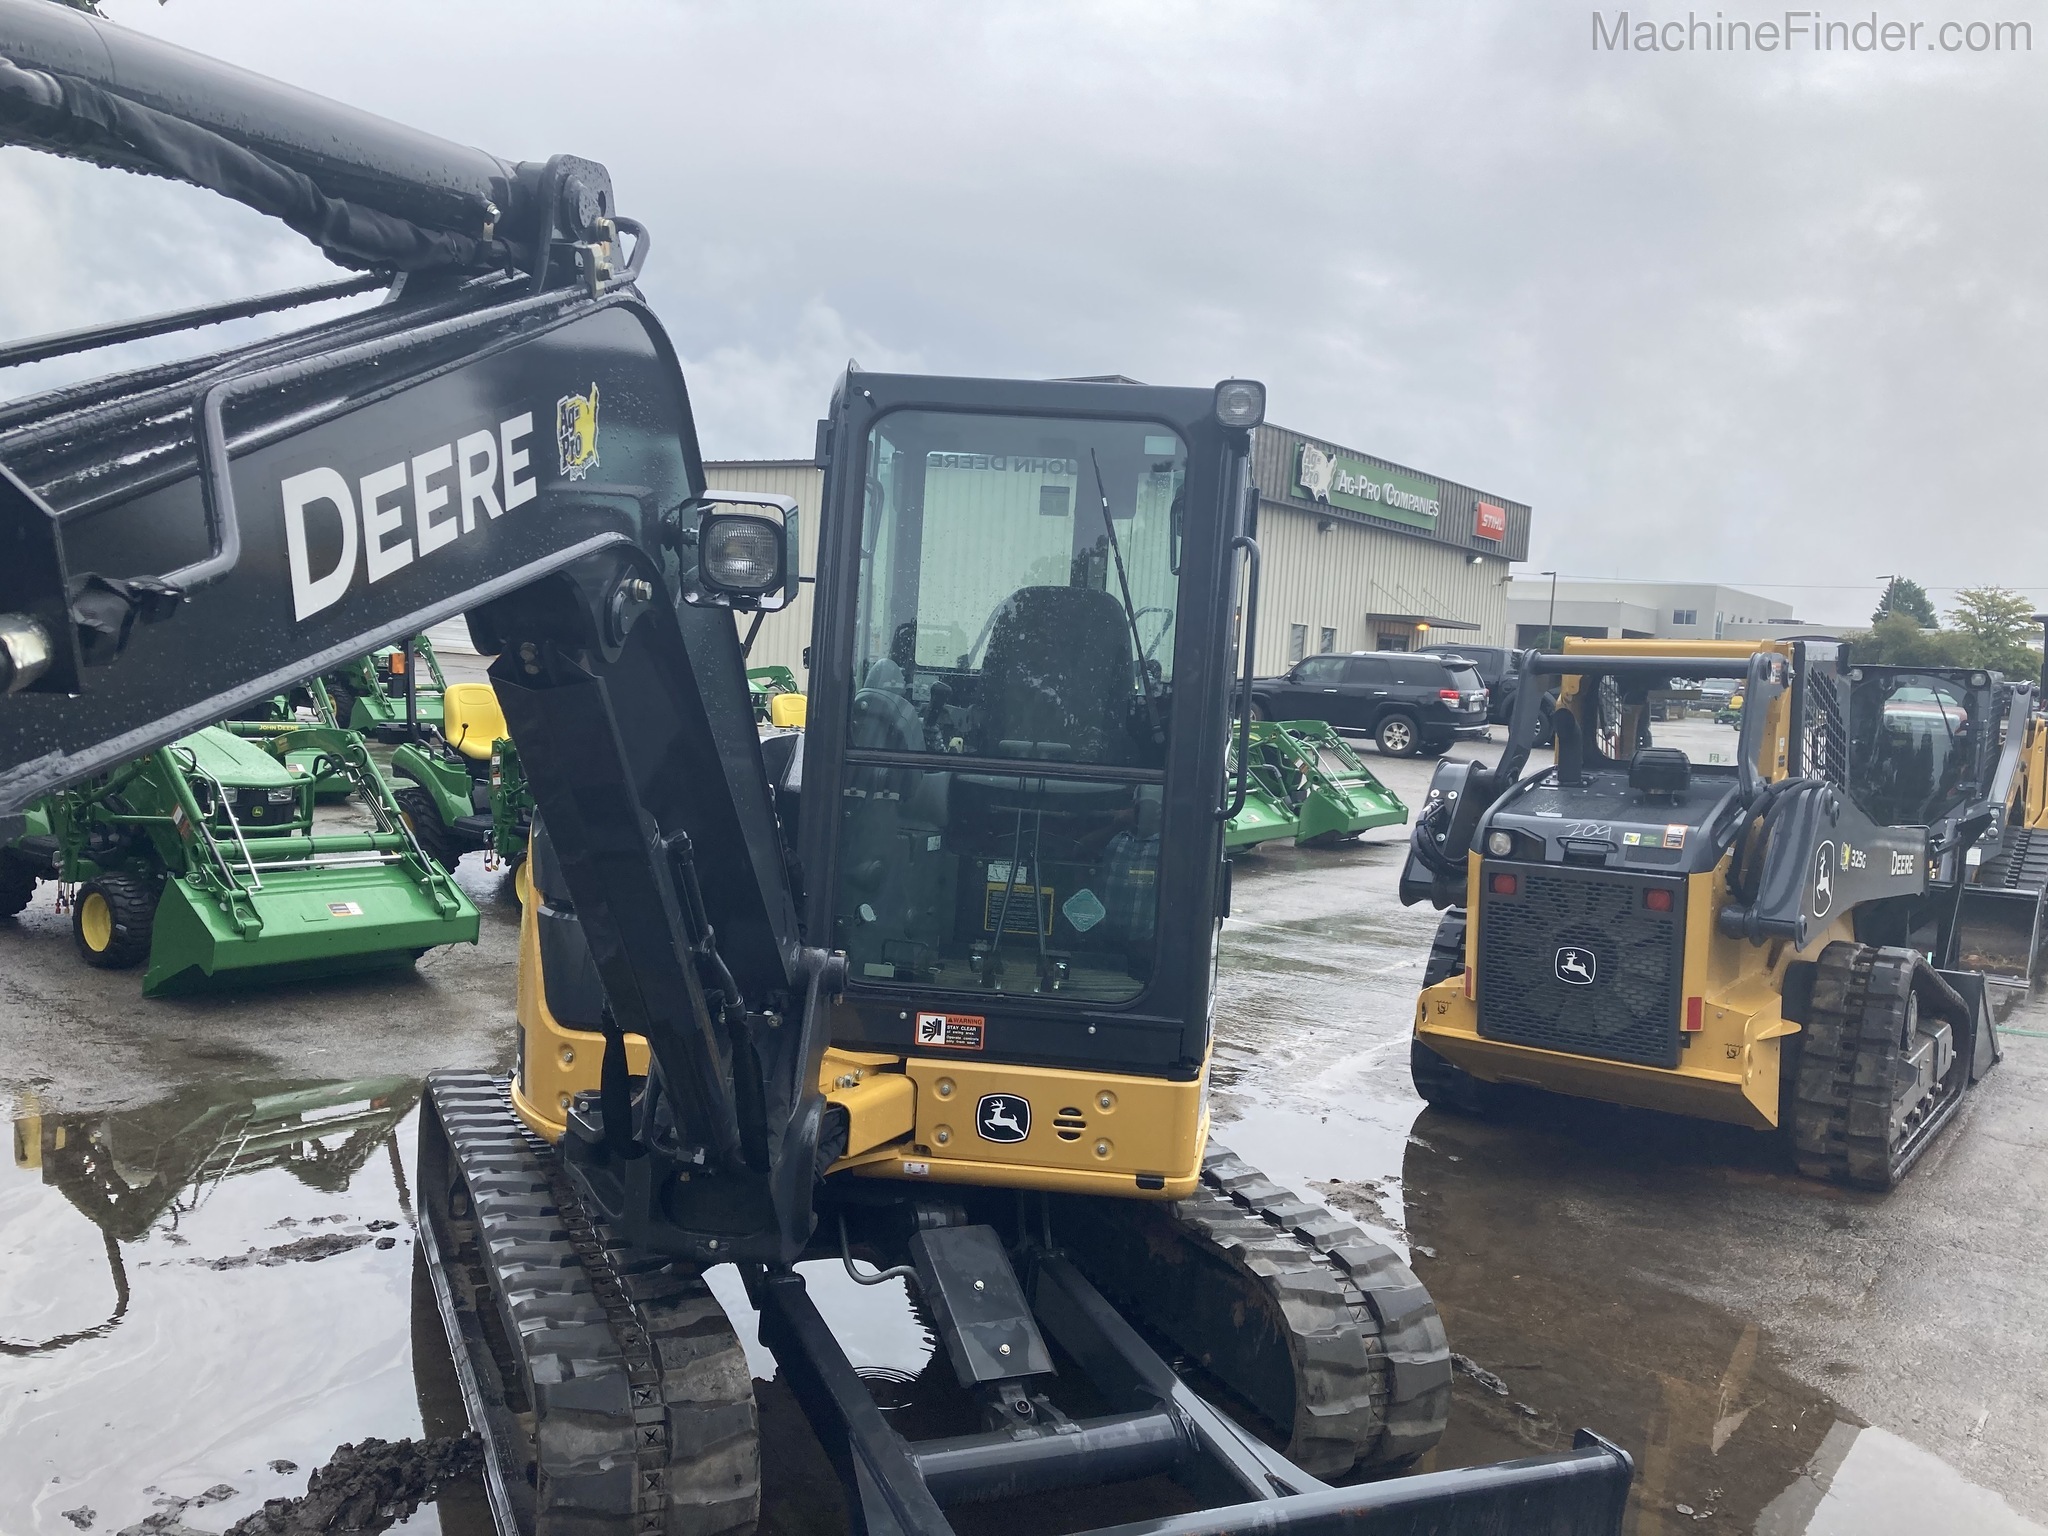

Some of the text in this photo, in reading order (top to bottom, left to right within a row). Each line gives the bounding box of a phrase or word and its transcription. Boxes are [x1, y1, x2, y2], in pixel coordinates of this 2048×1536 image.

[281, 411, 537, 623] DEERE
[1481, 514, 1503, 531] STIHL
[1851, 849, 1867, 869] 325G
[1891, 850, 1914, 876] DEERE
[953, 1017, 982, 1025] WARNING
